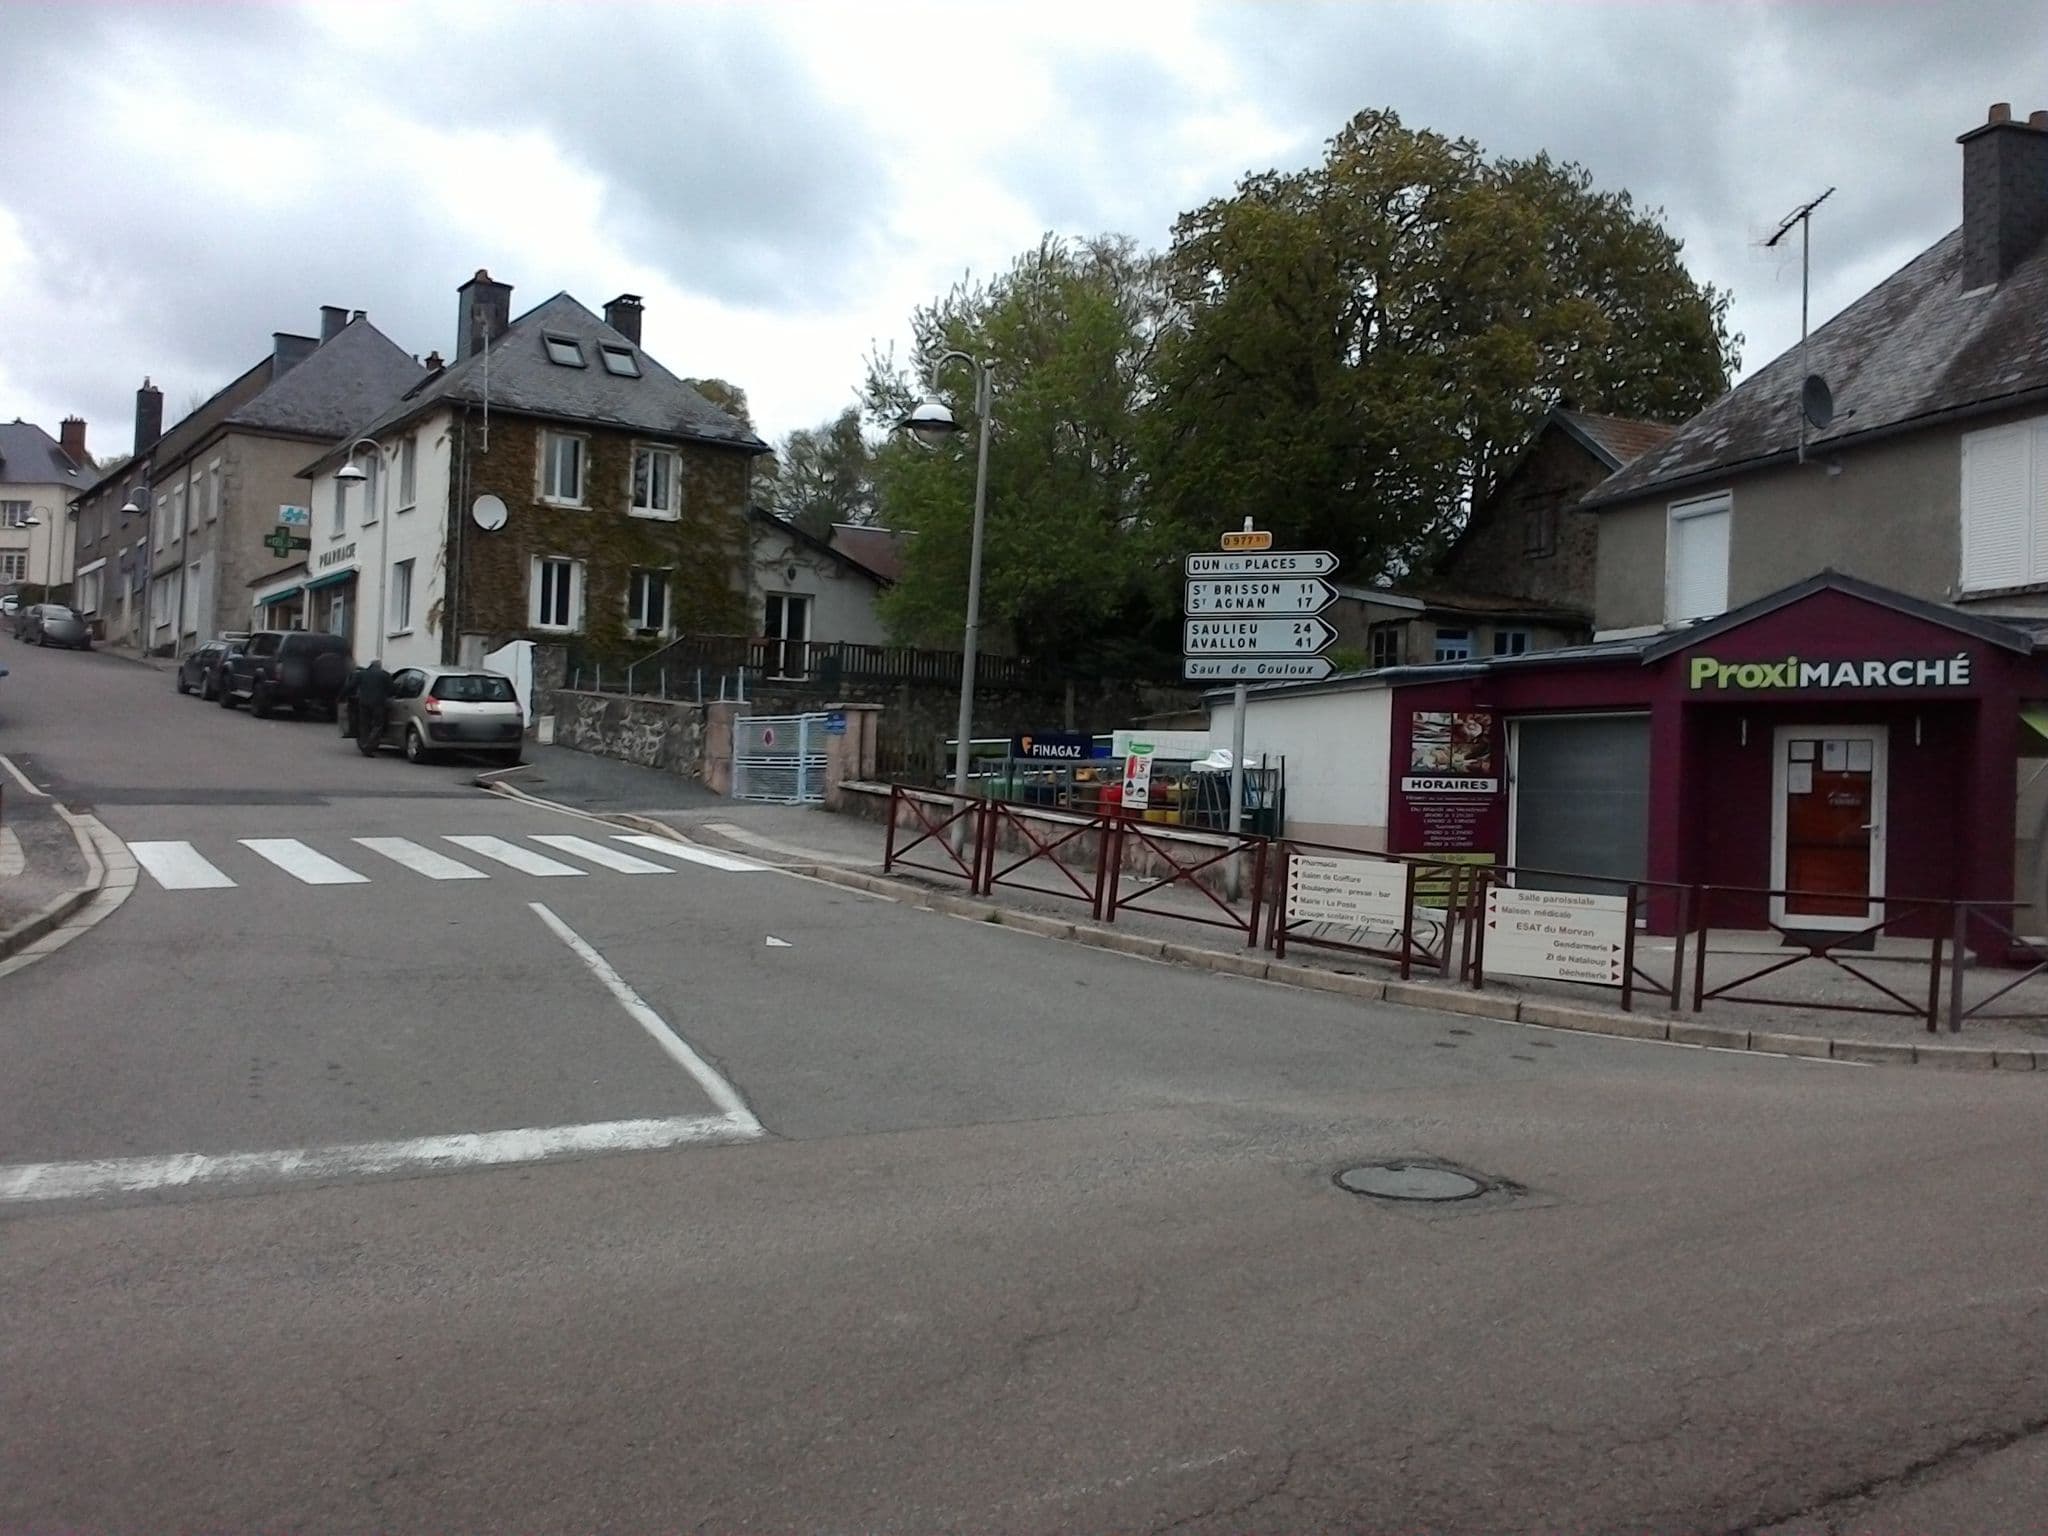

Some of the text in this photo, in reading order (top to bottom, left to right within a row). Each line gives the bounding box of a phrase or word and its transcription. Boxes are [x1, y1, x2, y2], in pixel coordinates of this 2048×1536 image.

[1233, 536, 1253, 545] 977
[320, 542, 357, 568] PHARMACIE
[1193, 558, 1323, 570] DUN LES PLACES 9
[1214, 584, 1280, 595] BRISSON
[1300, 583, 1314, 594] 11
[1215, 598, 1266, 609] AGNAN
[1297, 598, 1313, 608] 17
[1192, 623, 1312, 635] SAULIEU 24
[1191, 637, 1312, 649] AVALLON 41
[1190, 663, 1314, 675] Saut de Gouloux
[1032, 744, 1081, 758] FINAGAZ
[1411, 779, 1489, 790] HORAIRES
[1302, 872, 1321, 880] Salon
[1301, 884, 1342, 894] Boulangerie
[1348, 888, 1372, 897] presse
[1300, 896, 1320, 905] Mairie
[1327, 898, 1335, 907] La
[1337, 899, 1357, 909] Poste
[1518, 893, 1595, 906] Salle paroissiale
[1299, 909, 1324, 918] Groupe
[1360, 915, 1394, 925] Gymnase
[1501, 906, 1572, 919] Maison médicale
[1516, 922, 1594, 937] ESAT du Morvan
[1553, 940, 1607, 951] Gendarmerie
[1556, 954, 1566, 962] de
